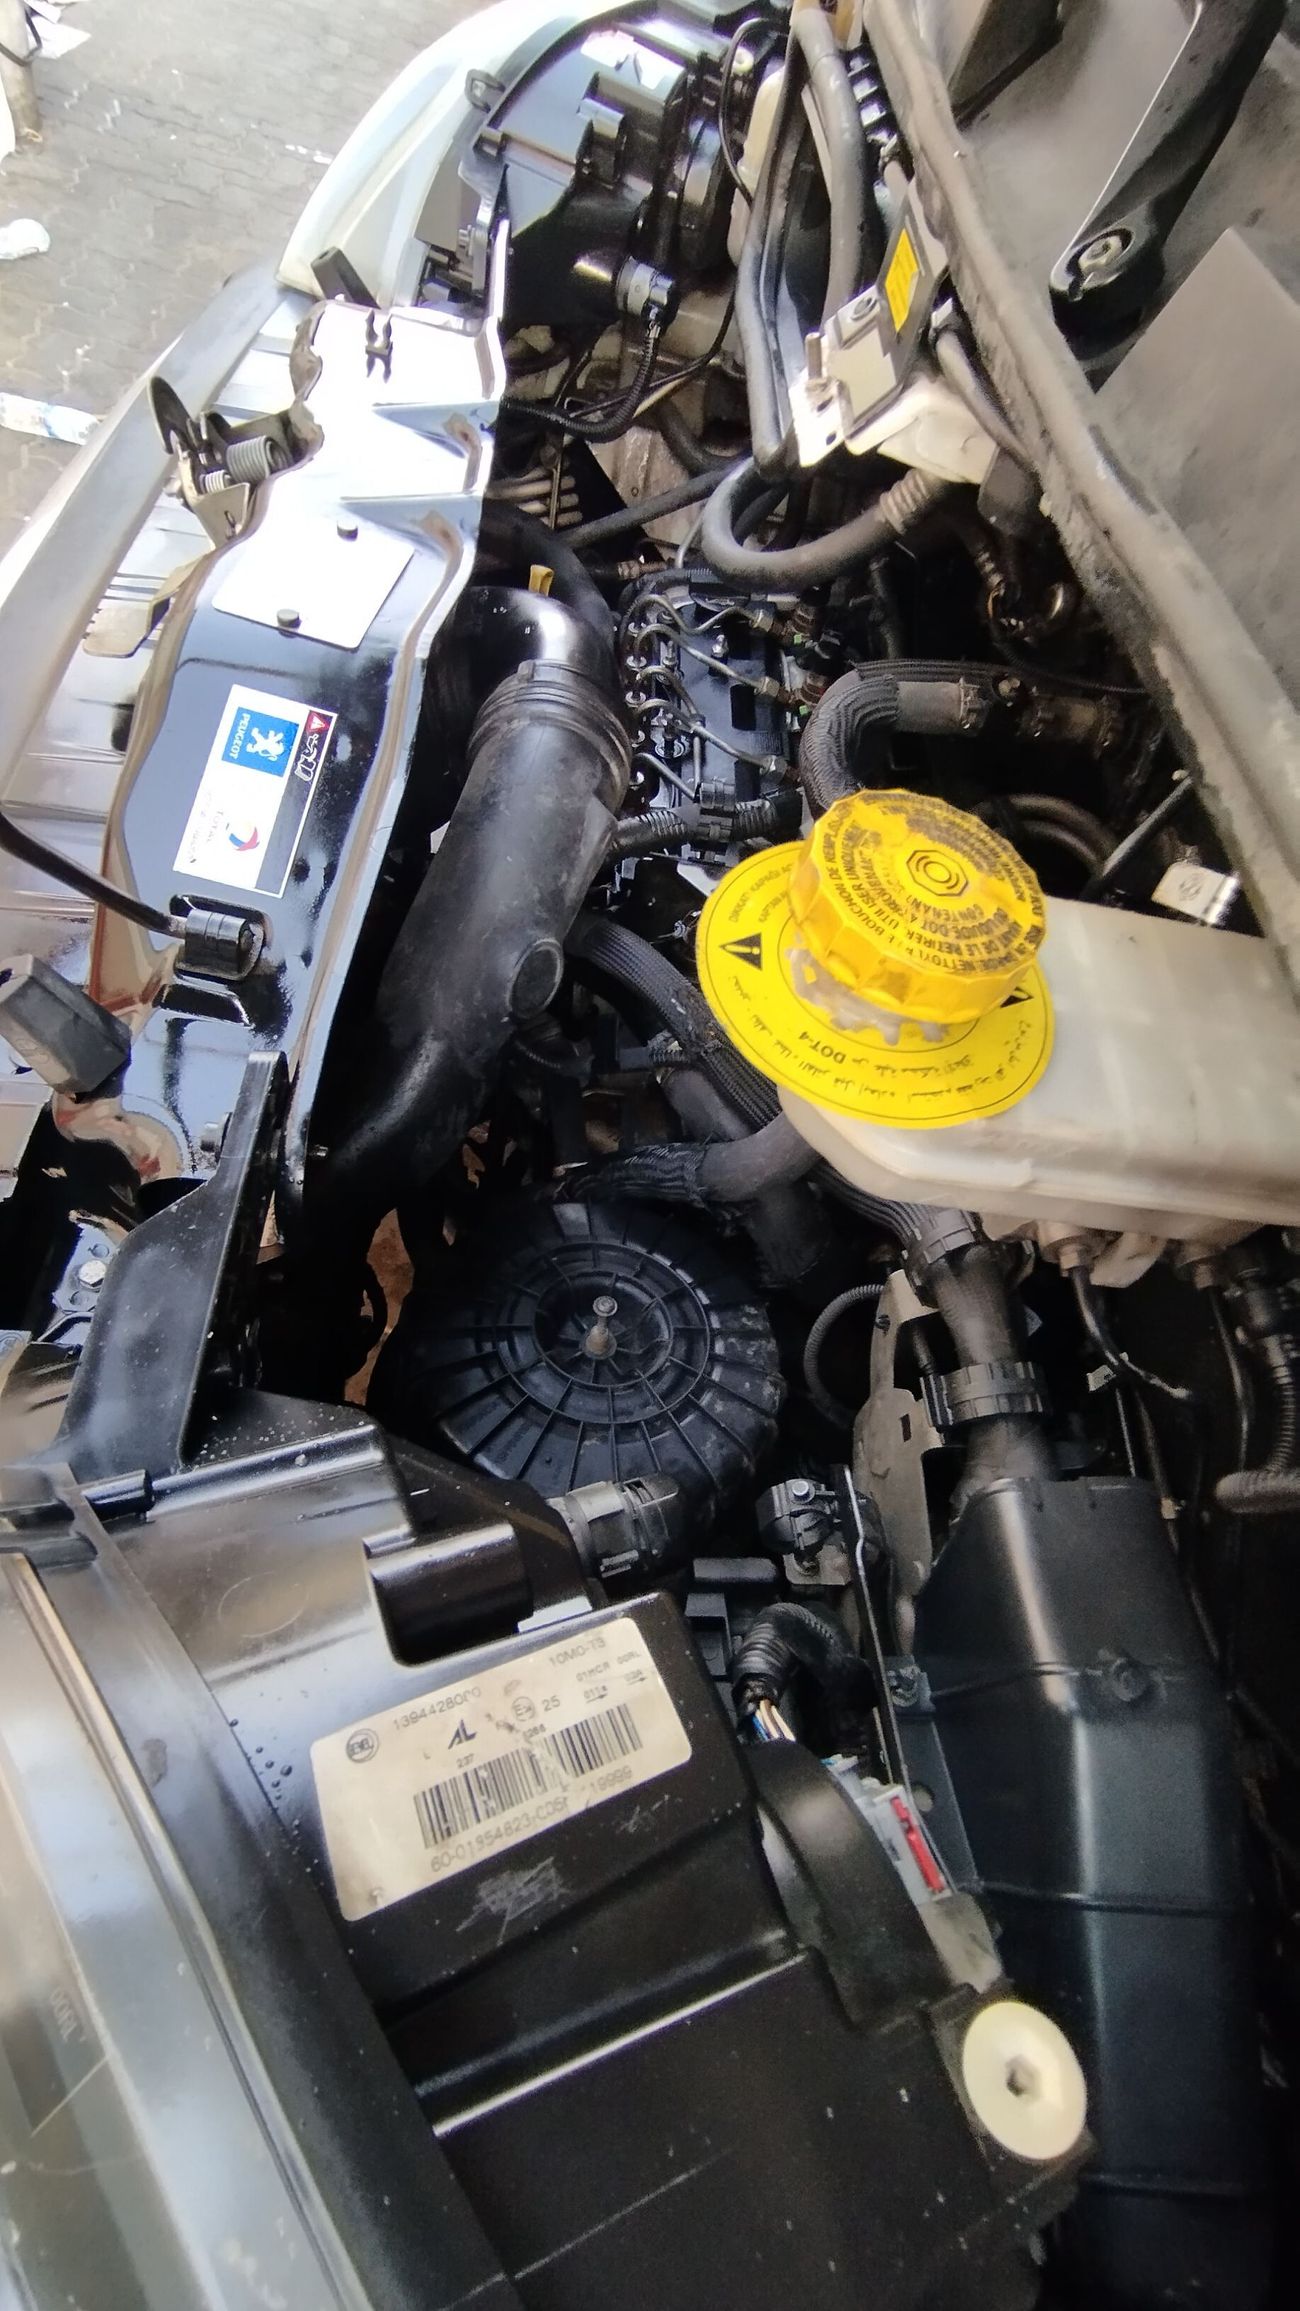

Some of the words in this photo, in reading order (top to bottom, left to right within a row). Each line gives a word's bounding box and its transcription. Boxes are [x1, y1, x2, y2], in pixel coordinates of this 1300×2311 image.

[229, 713, 251, 760] PEUGEOT
[826, 867, 842, 881] DE
[834, 883, 885, 936] BOUCHON
[852, 882, 899, 929] UTILISER
[920, 921, 949, 937] DOT
[966, 944, 981, 956] LE
[981, 940, 999, 954] DE
[797, 1033, 846, 1063] DOT-4
[542, 1696, 561, 1712] 25
[447, 1719, 477, 1750] AL
[457, 1753, 474, 1768] 237
